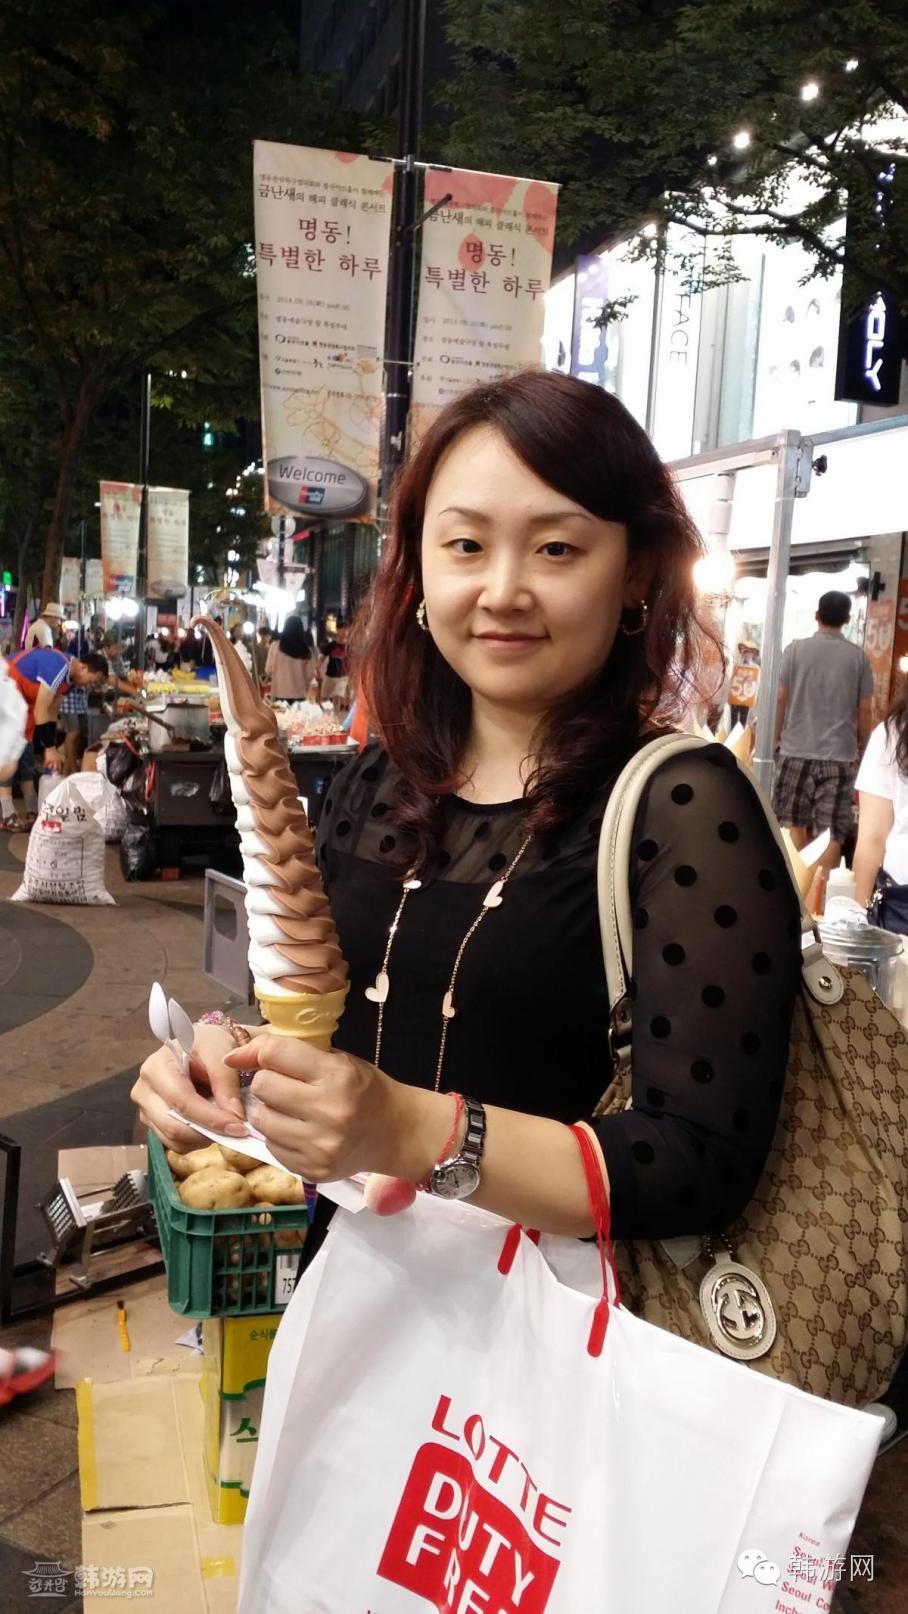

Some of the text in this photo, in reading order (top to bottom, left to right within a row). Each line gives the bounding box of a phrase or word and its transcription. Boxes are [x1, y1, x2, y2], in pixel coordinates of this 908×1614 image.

[258, 184, 387, 213] 금난새의 해피 클래식 콘서트
[298, 218, 351, 245] 명동!
[496, 221, 522, 233] 클래식
[258, 242, 382, 281] 특별한 하루
[465, 241, 517, 267] 명동!
[424, 266, 545, 301] 특별한 하루
[278, 463, 346, 486] Welcome
[432, 1394, 572, 1547] LOTTE
[423, 1472, 536, 1607] DUTY
[405, 1524, 510, 1614] FRE
[780, 1581, 812, 1603] Seoul
